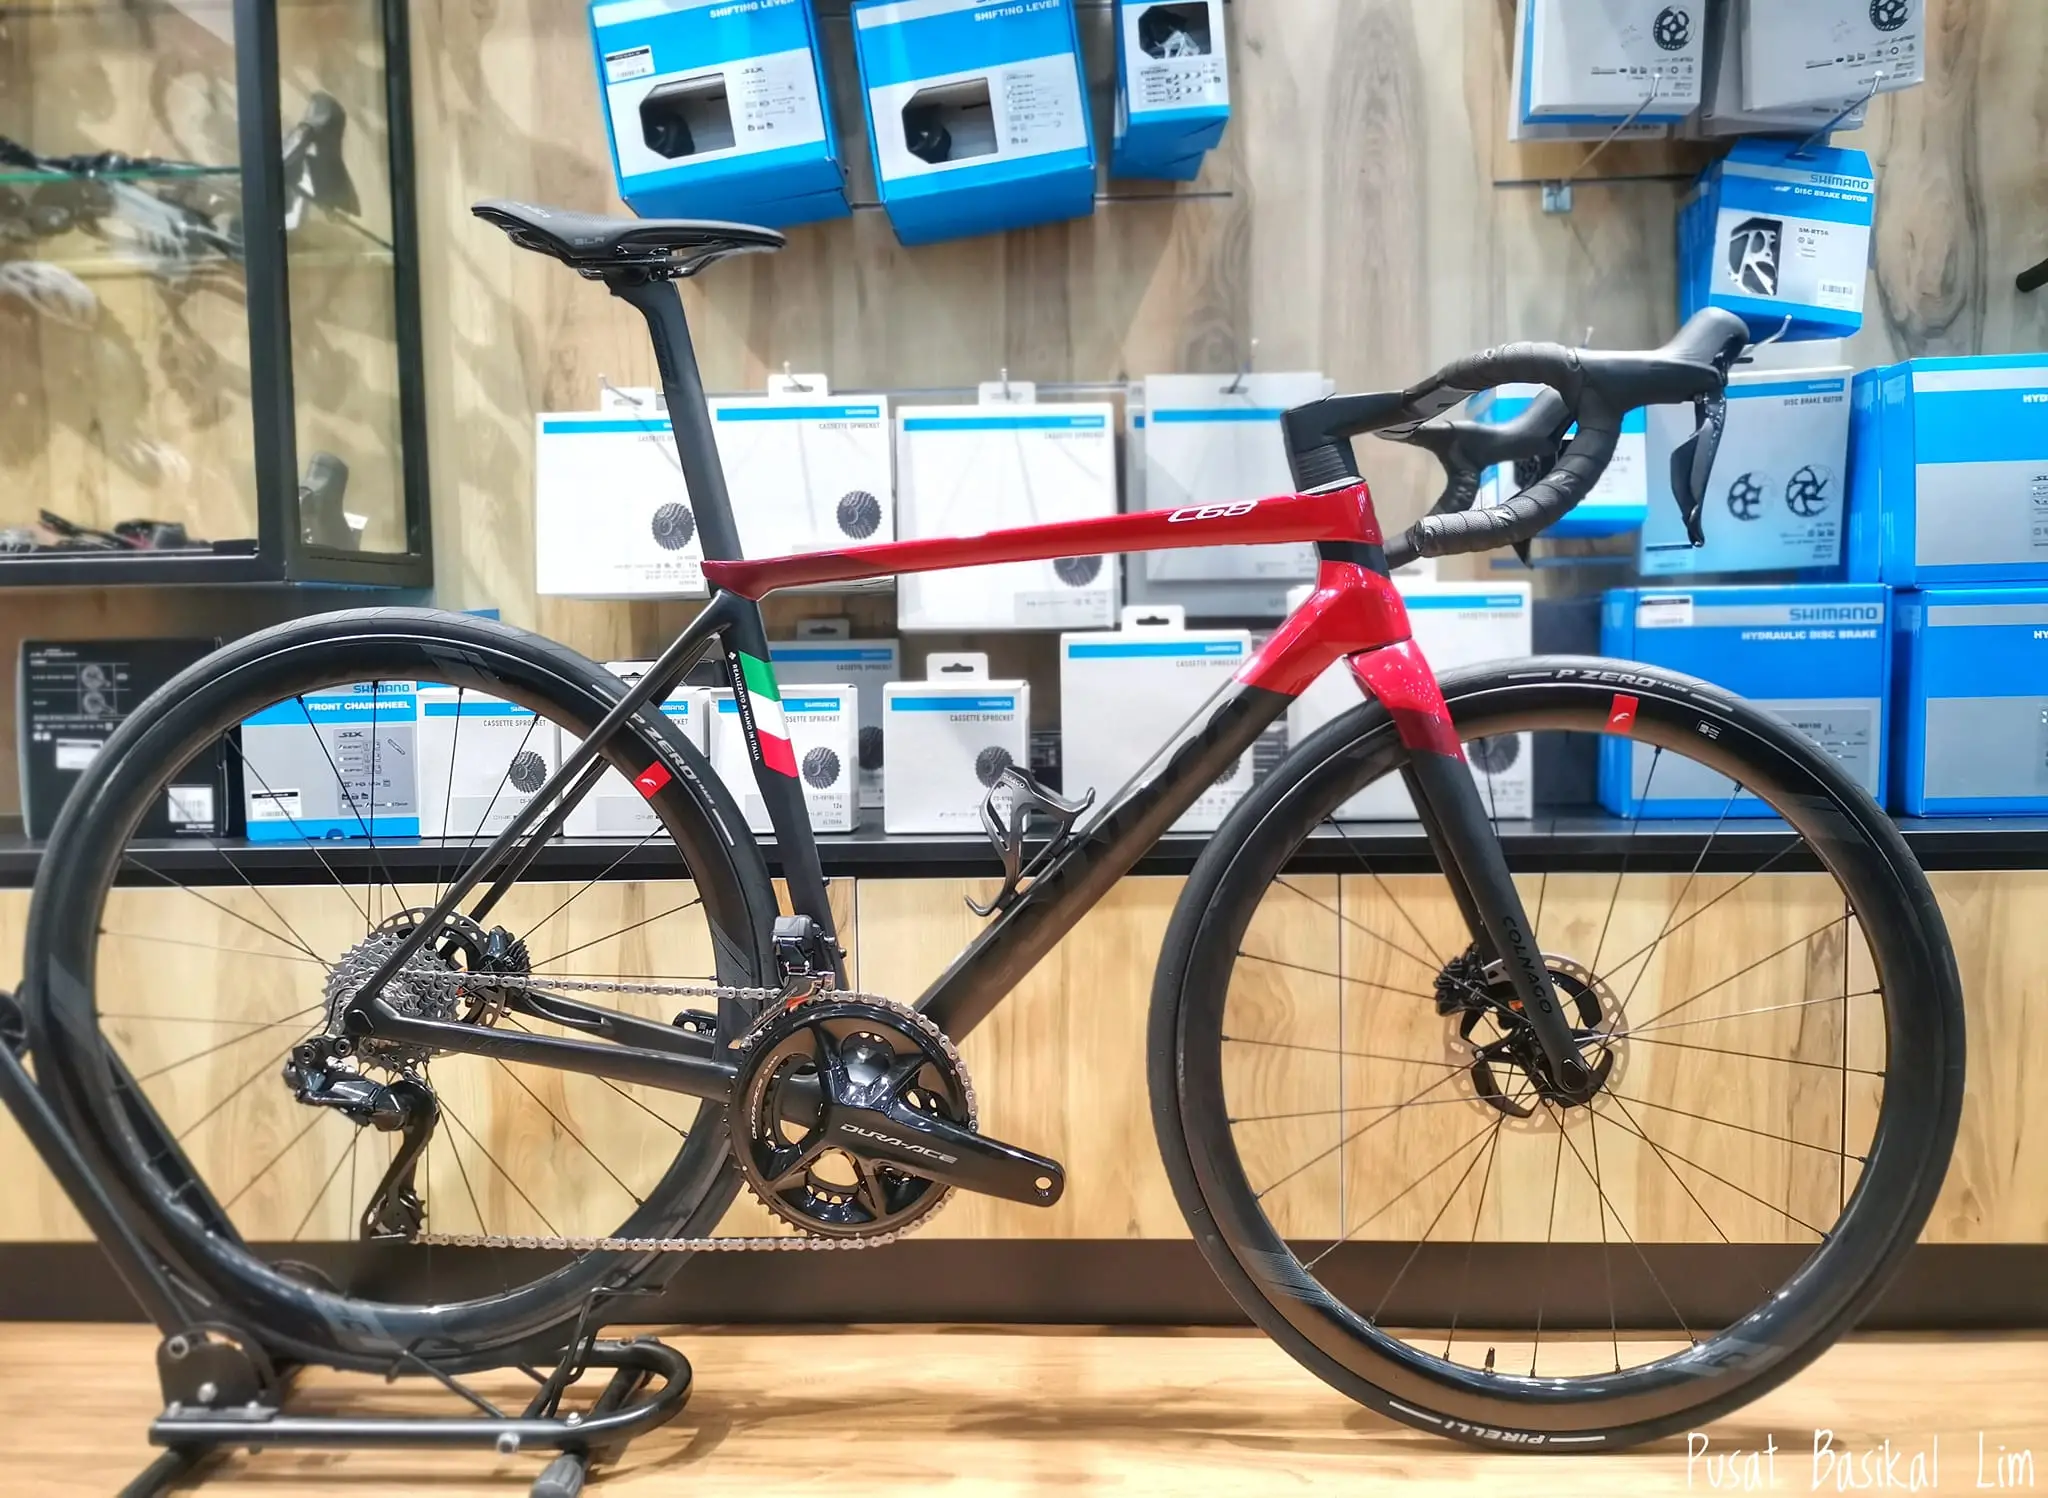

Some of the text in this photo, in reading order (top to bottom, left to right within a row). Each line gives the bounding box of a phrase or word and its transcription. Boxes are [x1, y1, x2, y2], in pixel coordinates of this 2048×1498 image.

[709, 1, 759, 18] SHIFTING
[974, 6, 1023, 21] SHIFTING
[1810, 174, 1869, 190] SHIMANO
[1794, 187, 1868, 202] DISC BRAKE ROTOR
[1168, 500, 1258, 522] C68
[1789, 606, 1877, 621] SHIMANO
[1742, 629, 1877, 641] HYDRAULIC DISC BRAKE
[732, 664, 746, 703] REALIZZATO
[1556, 669, 1576, 679] P
[1579, 670, 1657, 687] ZERO
[308, 701, 411, 711] FRONT CHAINWHEEL
[743, 711, 753, 730] MANO
[950, 714, 980, 722] CASSETTE
[748, 731, 755, 739] IN
[630, 711, 646, 724] P
[644, 726, 697, 780] ZERO
[750, 740, 760, 761] ITALIA
[1503, 916, 1552, 1013] COLNAGO
[840, 1123, 958, 1164] DURA-ACE
[1445, 1420, 1546, 1444] PIRELLI
